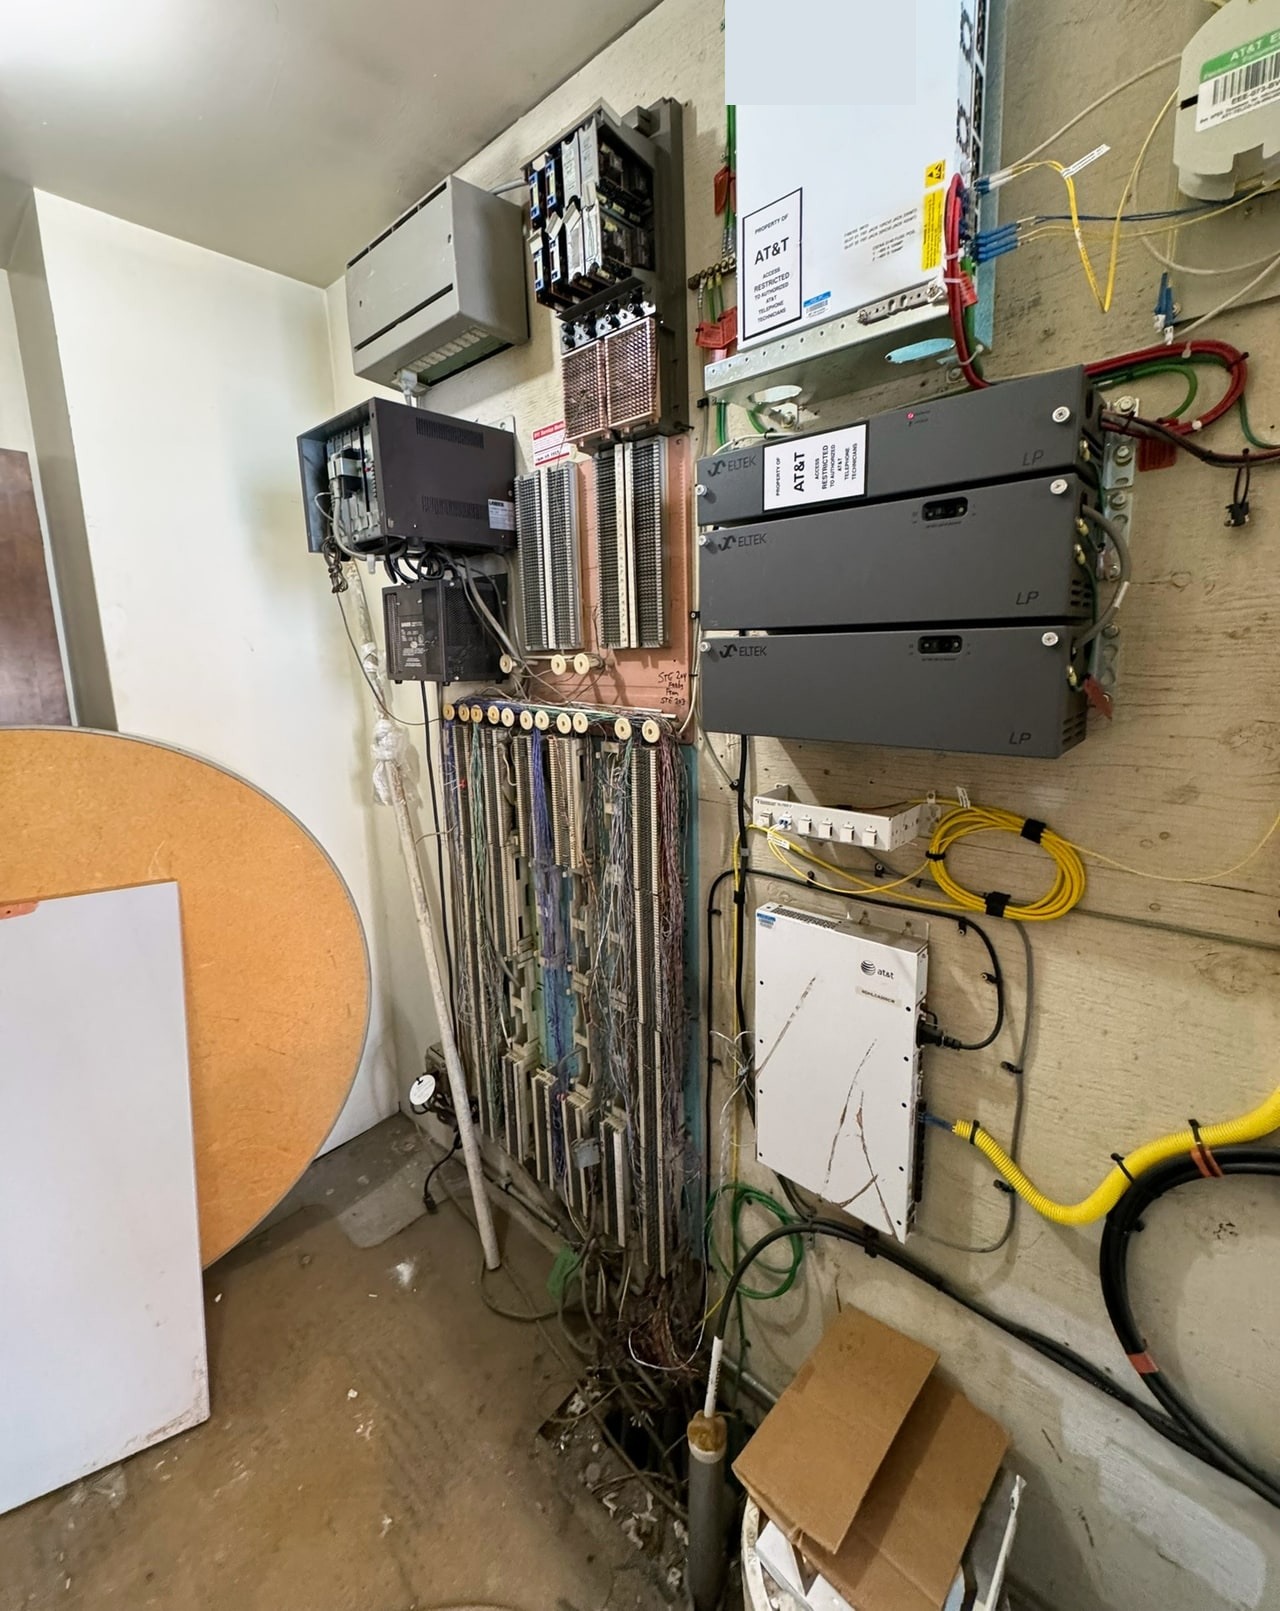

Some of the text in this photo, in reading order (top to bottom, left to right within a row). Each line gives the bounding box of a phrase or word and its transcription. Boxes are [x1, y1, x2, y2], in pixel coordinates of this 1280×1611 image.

[1230, 40, 1262, 62] AT&T
[755, 213, 789, 235] PROPERTY OF
[754, 237, 789, 265] AT&T
[762, 266, 781, 279] ACCESS
[754, 272, 790, 292] RESTRICTED
[761, 282, 789, 298] AUTHORIZED
[758, 300, 784, 314] TELEPHONE
[766, 295, 778, 304] AT&T
[757, 308, 786, 322] TECHNICIANS
[728, 455, 757, 472] ELTEK
[776, 457, 781, 465] OF
[1022, 450, 1044, 466] LP
[794, 452, 805, 492] AT&T
[830, 480, 835, 488] TO
[738, 533, 767, 548] ELTEK
[1016, 590, 1039, 606] LP
[739, 646, 767, 657] ELTEK
[1009, 732, 1032, 745] LP
[877, 969, 894, 980] at&t
